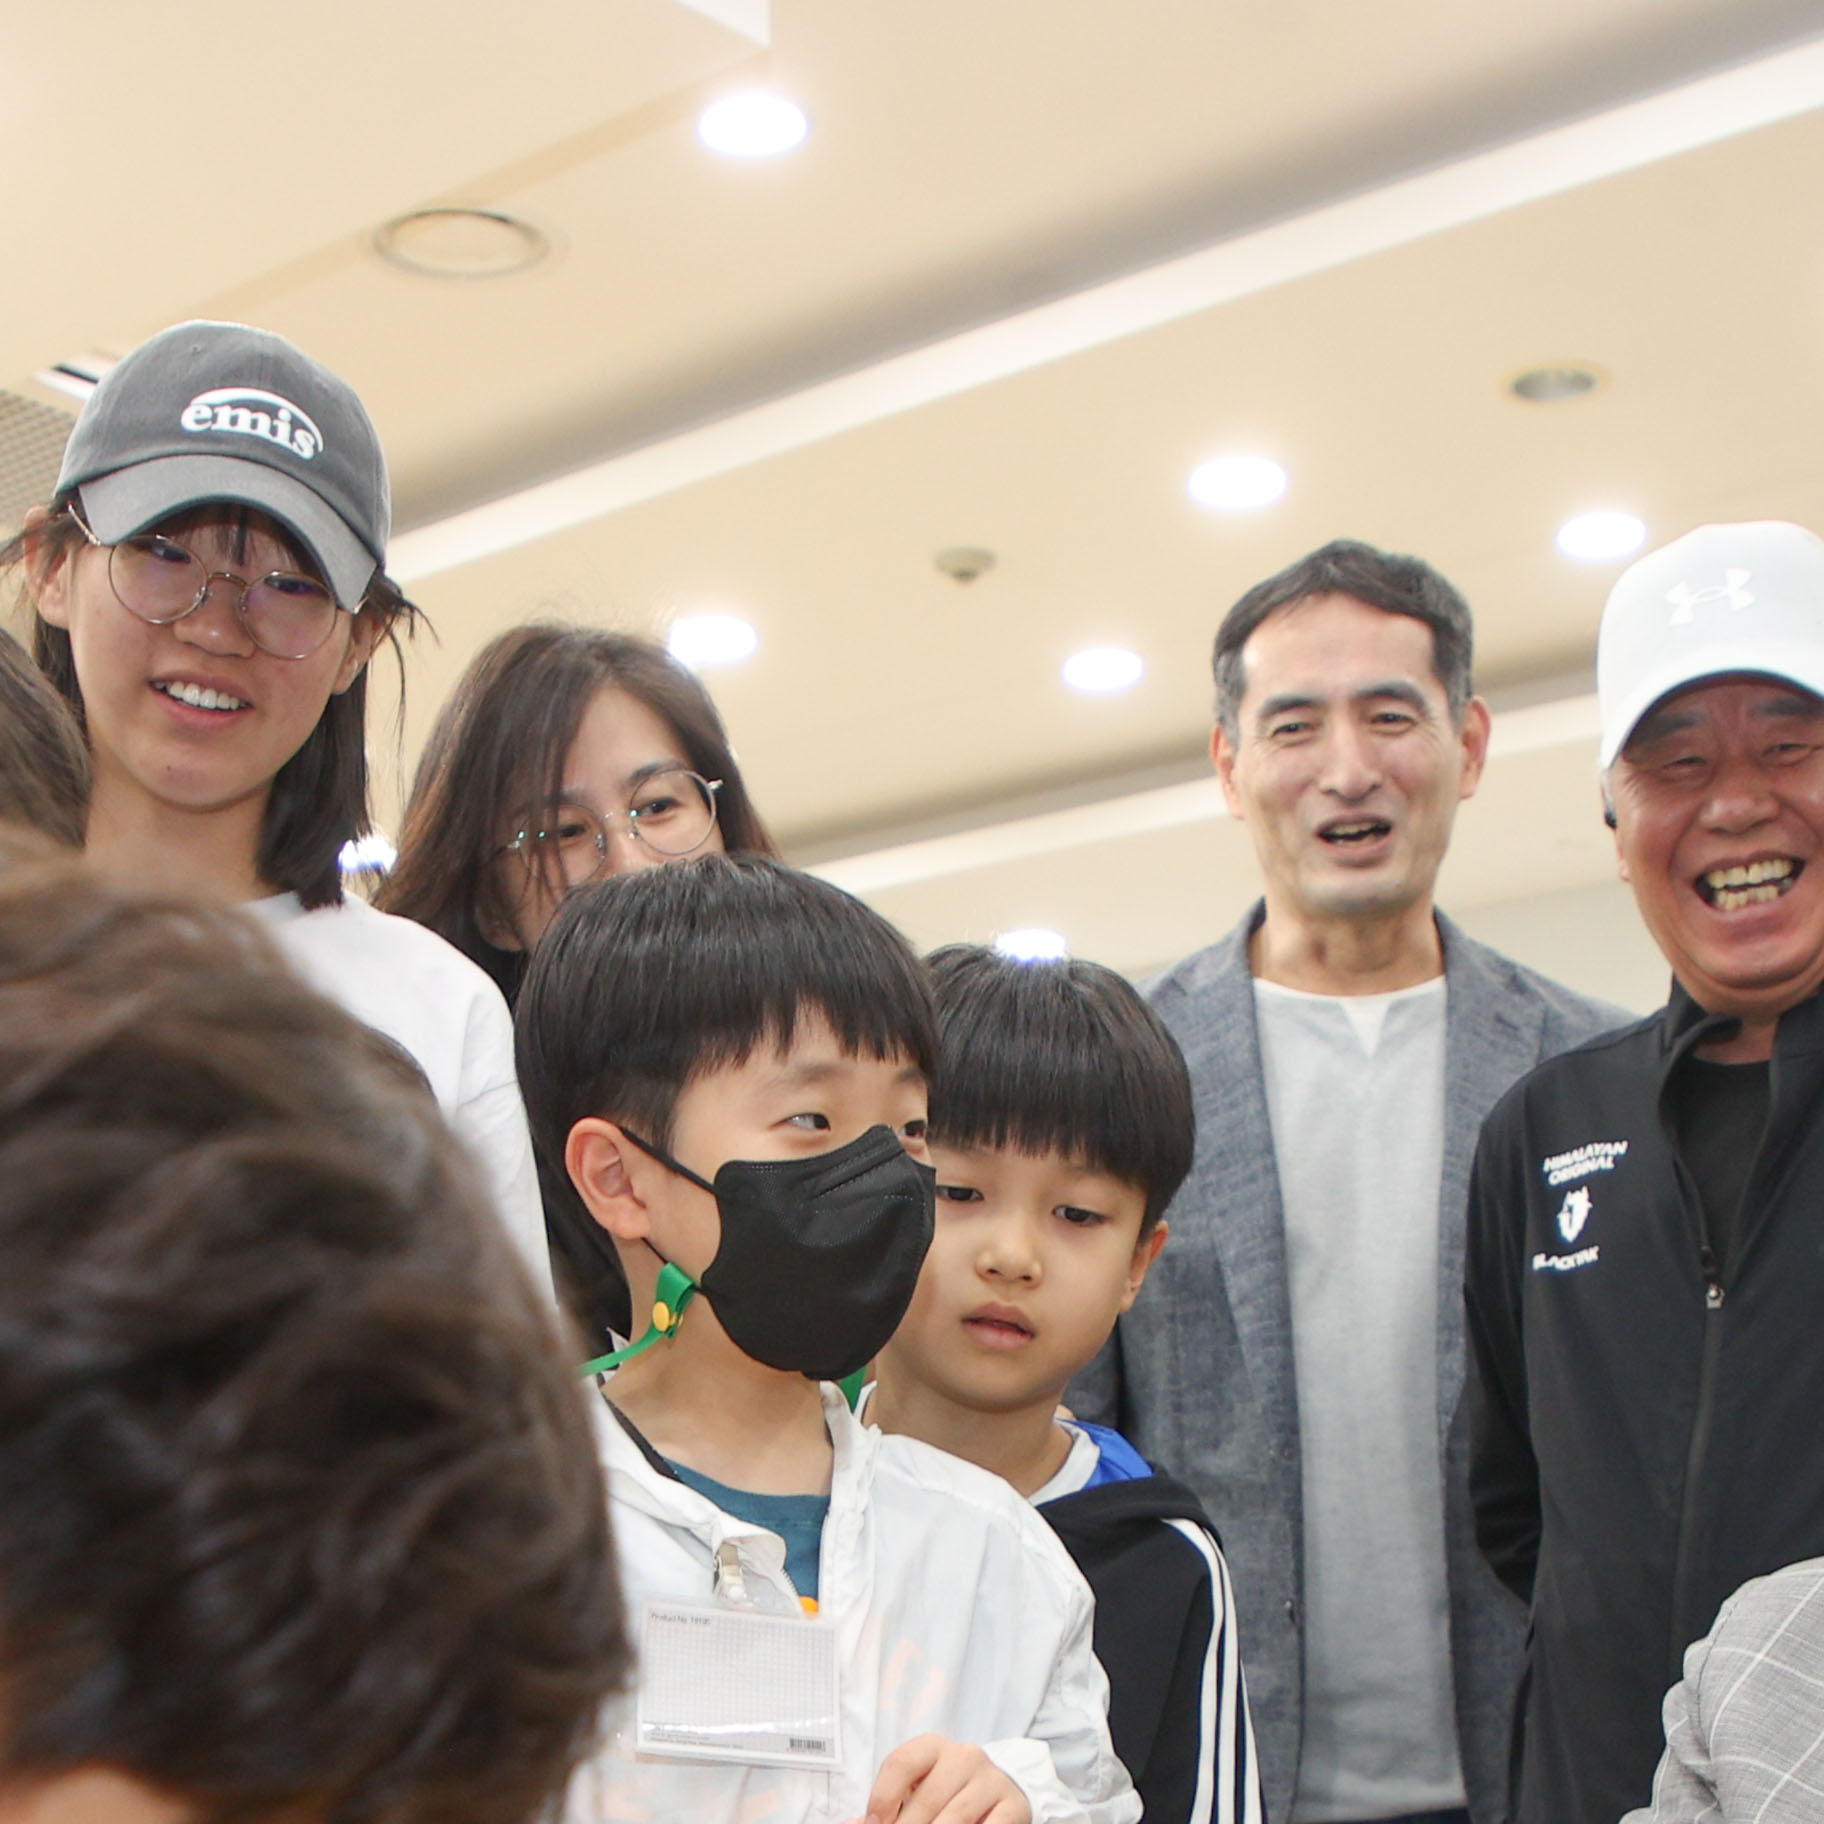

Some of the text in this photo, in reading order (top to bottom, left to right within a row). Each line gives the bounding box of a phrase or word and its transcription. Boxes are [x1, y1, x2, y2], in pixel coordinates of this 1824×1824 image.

[180, 401, 314, 460] emis
[1542, 1140, 1630, 1173] HIMALAYAN
[1547, 1155, 1616, 1187] ORIGINAL
